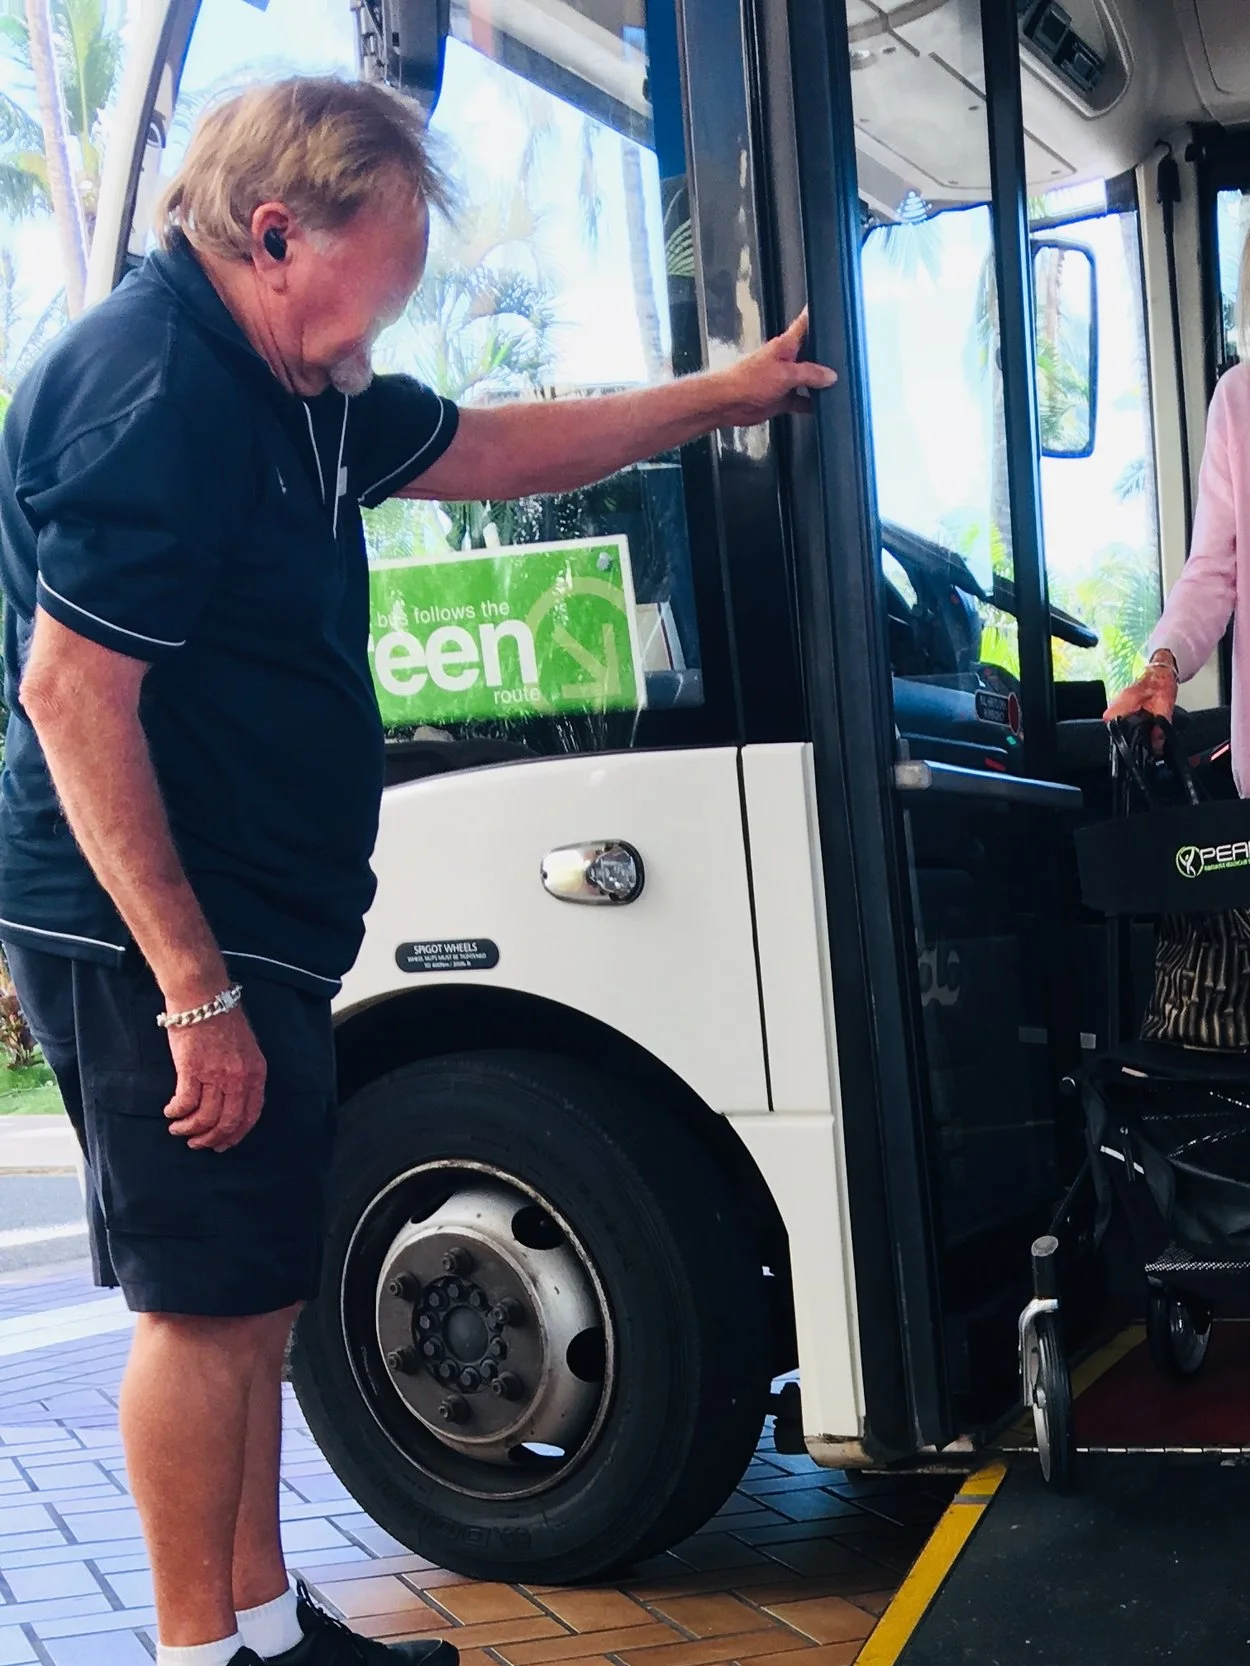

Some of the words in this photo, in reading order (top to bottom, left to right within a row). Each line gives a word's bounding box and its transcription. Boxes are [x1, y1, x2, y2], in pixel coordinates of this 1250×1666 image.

[414, 604, 476, 625] follows
[481, 600, 510, 619] the
[368, 619, 538, 697] een
[493, 686, 541, 705] route
[413, 944, 442, 955] SPIGOT
[443, 942, 478, 953] WHEELS
